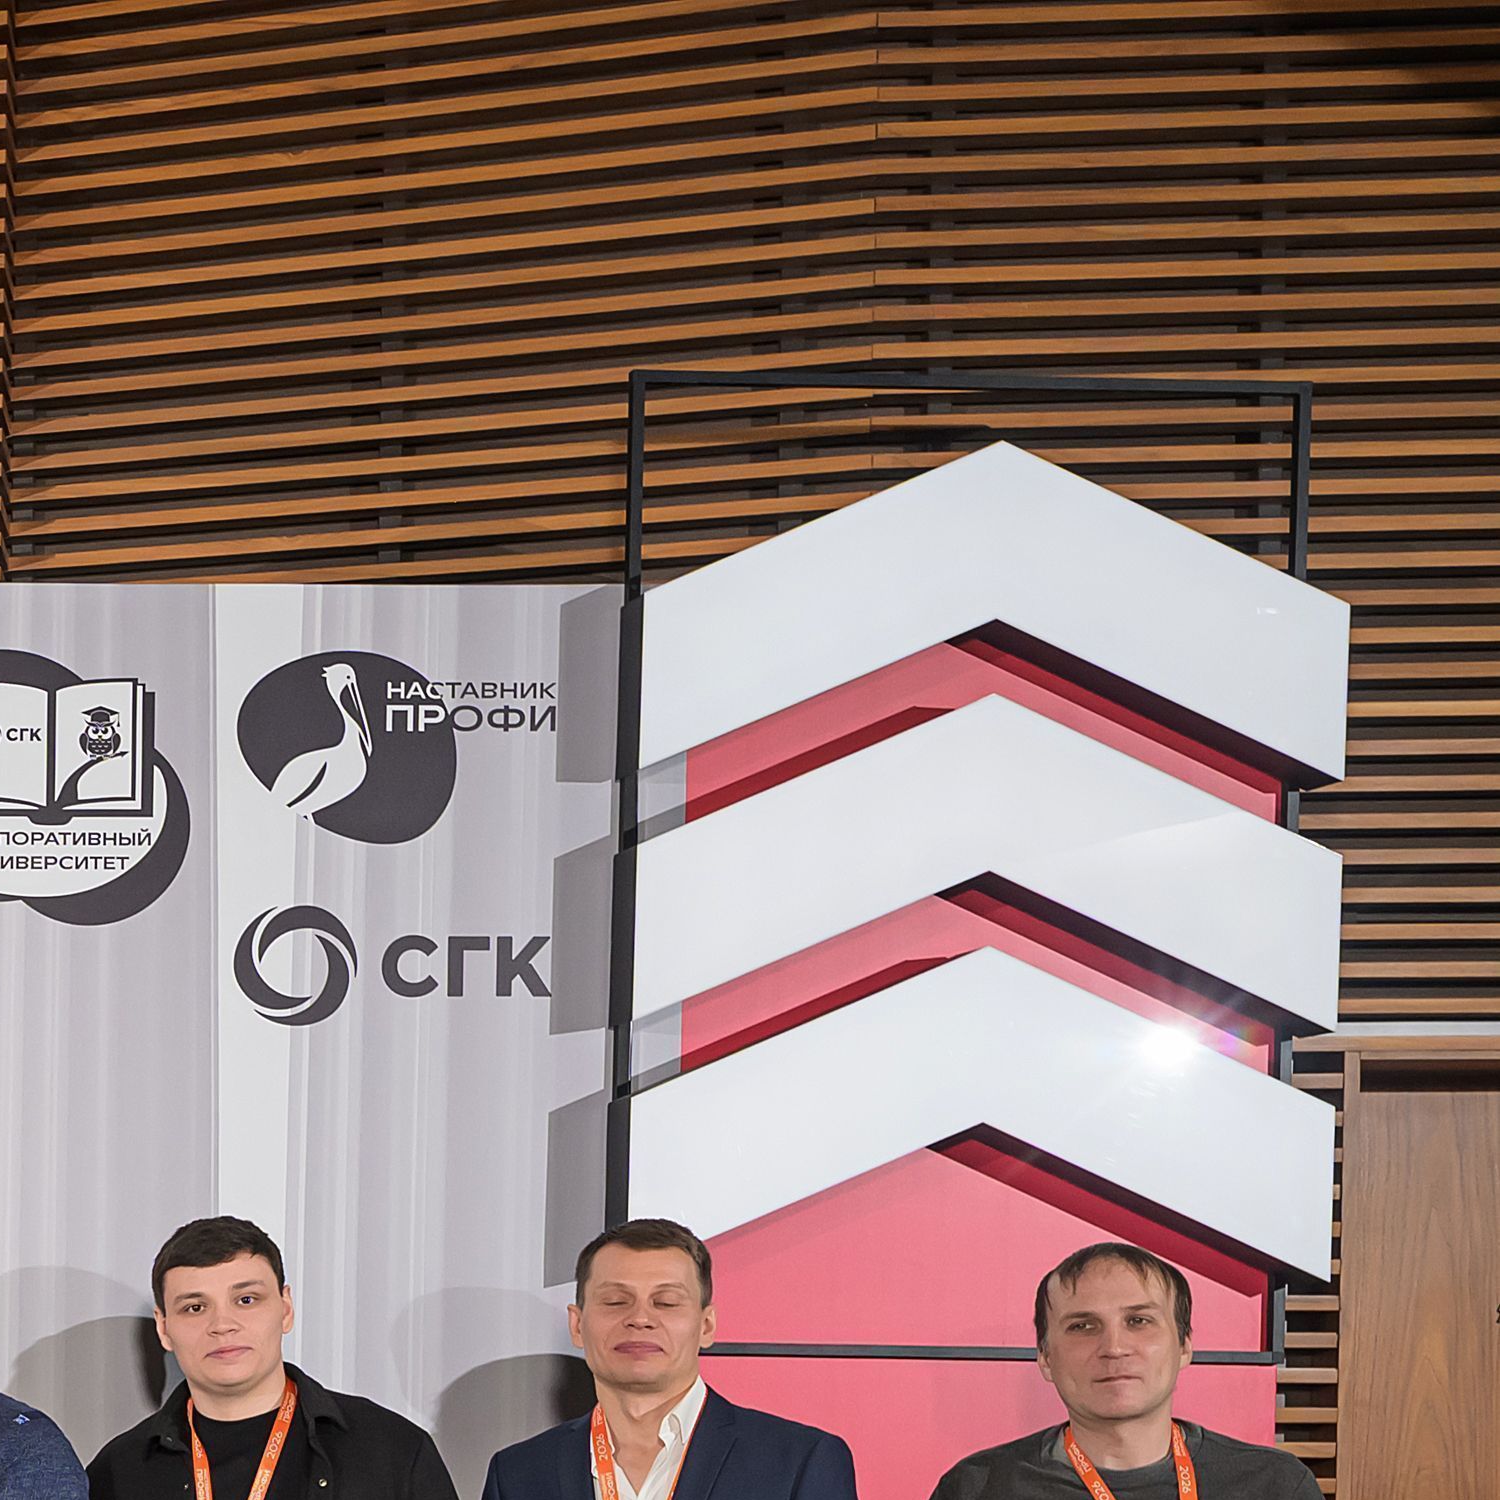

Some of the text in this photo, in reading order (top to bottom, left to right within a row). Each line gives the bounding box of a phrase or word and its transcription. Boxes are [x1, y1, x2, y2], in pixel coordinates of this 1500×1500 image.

[387, 681, 556, 699] НАСТАВНИК
[385, 703, 556, 733] ПРОФИ
[6, 727, 42, 742] СГК
[381, 934, 551, 997] СГК
[266, 1431, 283, 1460] 2026
[597, 1433, 607, 1460] 2026
[1179, 1465, 1191, 1495] 2026
